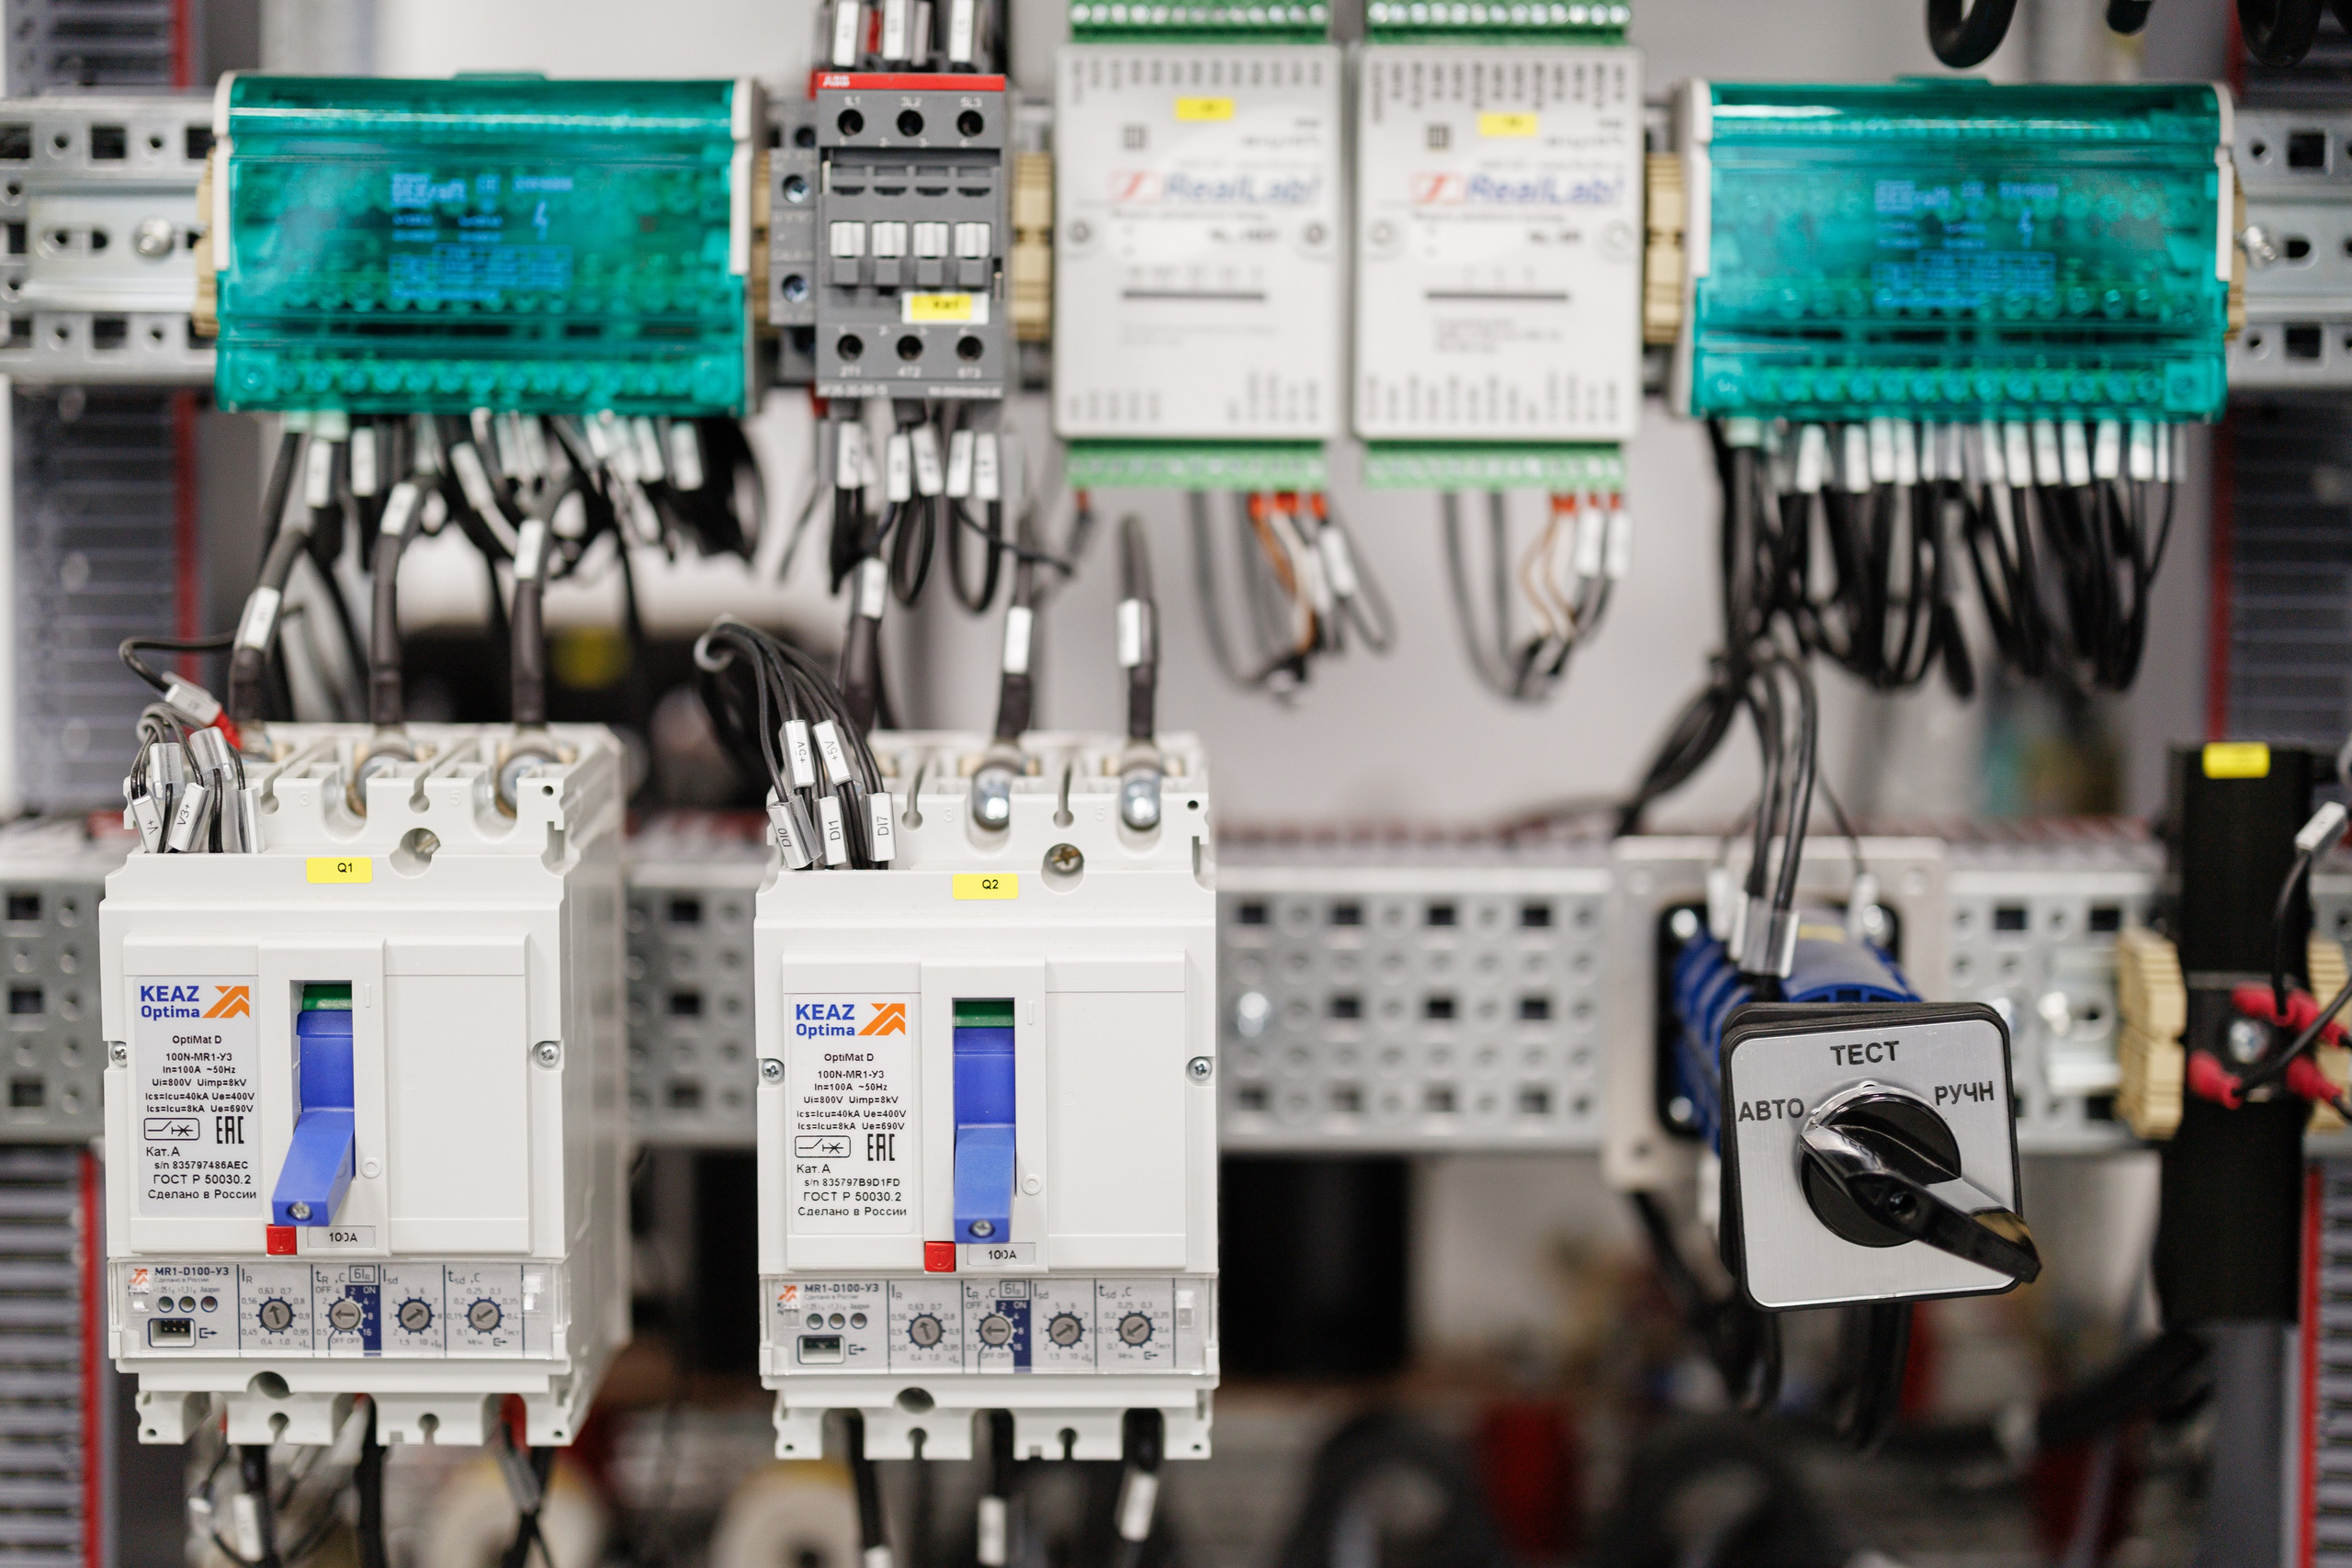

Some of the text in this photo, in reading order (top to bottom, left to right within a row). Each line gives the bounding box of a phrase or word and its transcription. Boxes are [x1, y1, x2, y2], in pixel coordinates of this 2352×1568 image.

[824, 740, 838, 761] +5V
[177, 803, 190, 827] V3+
[829, 819, 841, 841] DI1
[876, 816, 889, 837] DI7
[338, 863, 353, 873] Q1
[982, 880, 999, 890] Q2
[141, 986, 199, 1002] KEAZ
[141, 1005, 200, 1021] Optima
[796, 1004, 854, 1021] KEAZ
[796, 1023, 855, 1039] Optima
[173, 1035, 222, 1046] OptiMat D
[1830, 1040, 1900, 1066] ТЕСТ
[824, 1054, 874, 1064] OptiMat D
[164, 1066, 201, 1074] In=100A
[153, 1078, 247, 1089] Ui=800V Uimp=8kV
[1935, 1080, 1995, 1106] РУЧН
[849, 1096, 899, 1105] Uimp=8kV
[797, 1110, 907, 1118] Ics=Icu=40kA Ue=400V
[1738, 1098, 1804, 1122] АВТО
[154, 1161, 249, 1169] s/n 835797486AEC
[153, 1174, 251, 1184] ГОСТ Р 50030.2
[822, 1179, 900, 1187] 835797B9D1FD
[148, 1190, 199, 1200] Сделано
[215, 1190, 256, 1199] России
[803, 1192, 901, 1201] ГОСТ Р 50030.2
[797, 1207, 849, 1216] Сделано
[865, 1207, 907, 1216] России
[329, 1232, 358, 1243] 100A
[989, 1250, 1017, 1260] 100A
